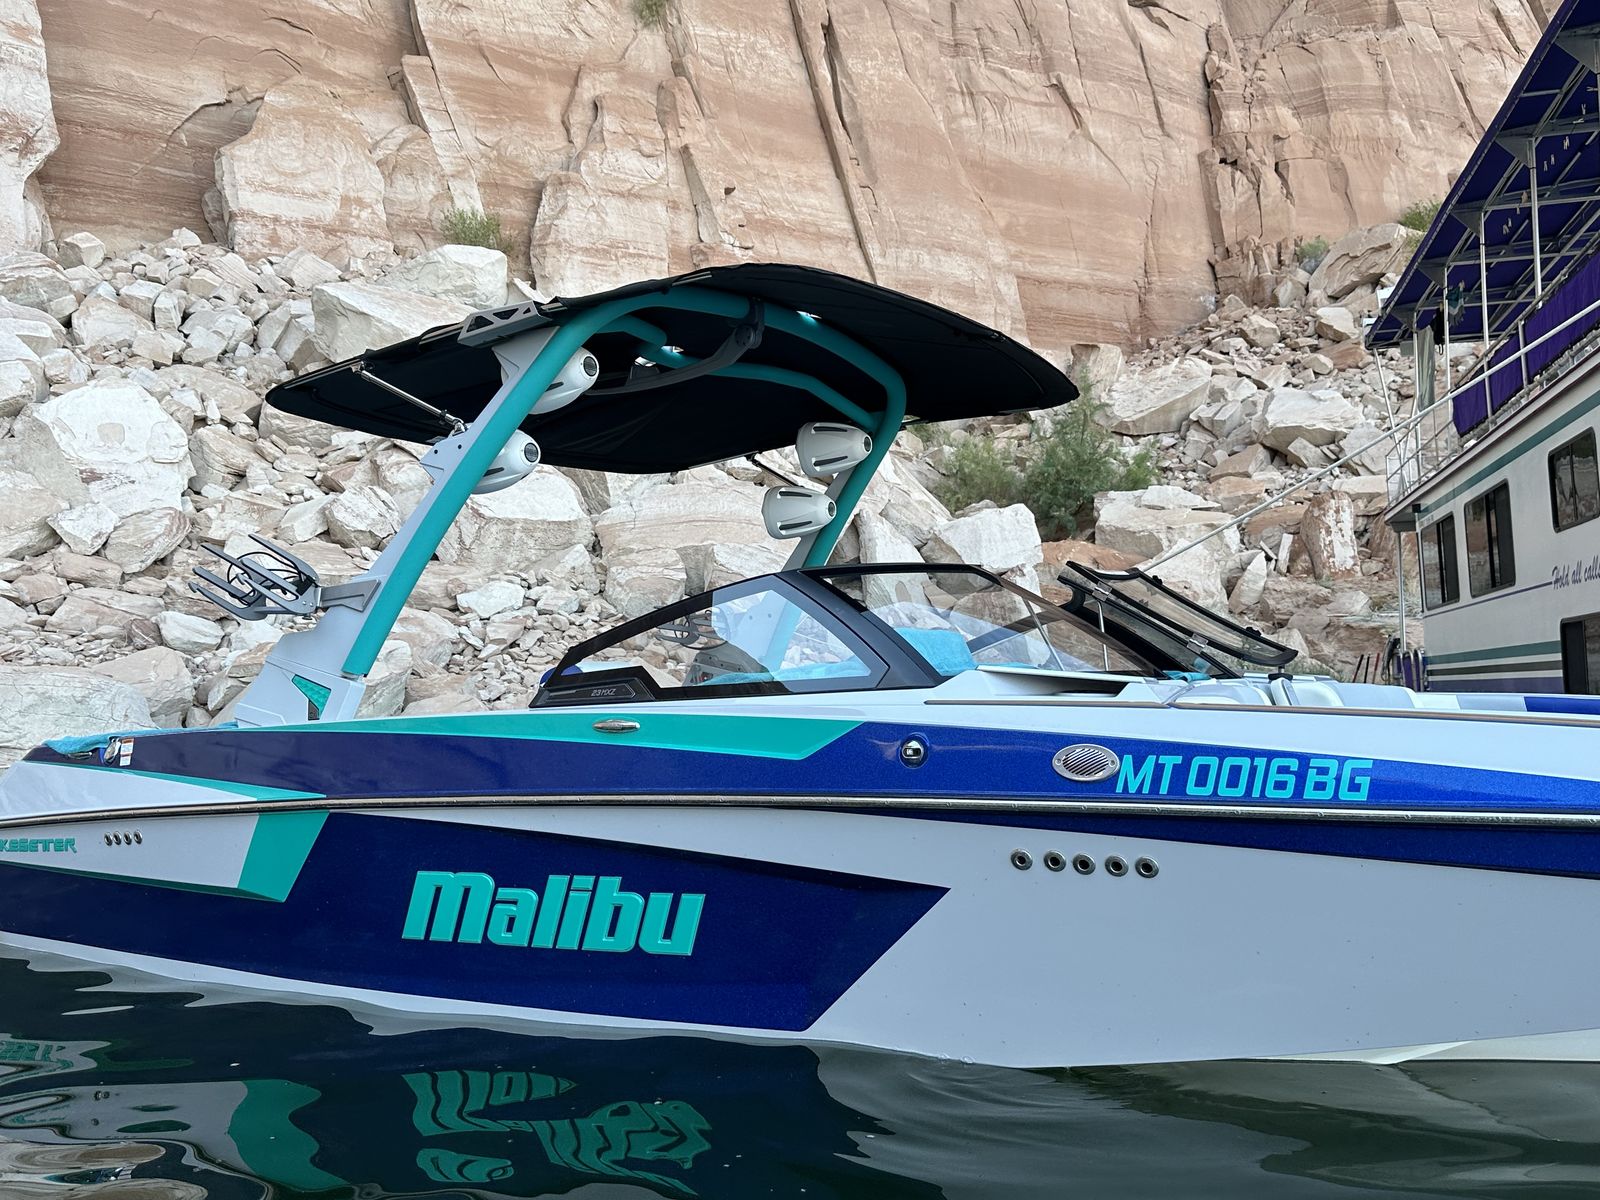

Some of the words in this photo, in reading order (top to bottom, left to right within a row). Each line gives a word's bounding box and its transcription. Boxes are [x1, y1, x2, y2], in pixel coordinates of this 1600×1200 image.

[1571, 559, 1583, 585] all
[1115, 754, 1183, 795] MT
[1186, 756, 1299, 799] 0016
[1303, 758, 1374, 801] BG
[401, 870, 706, 956] Malibu
